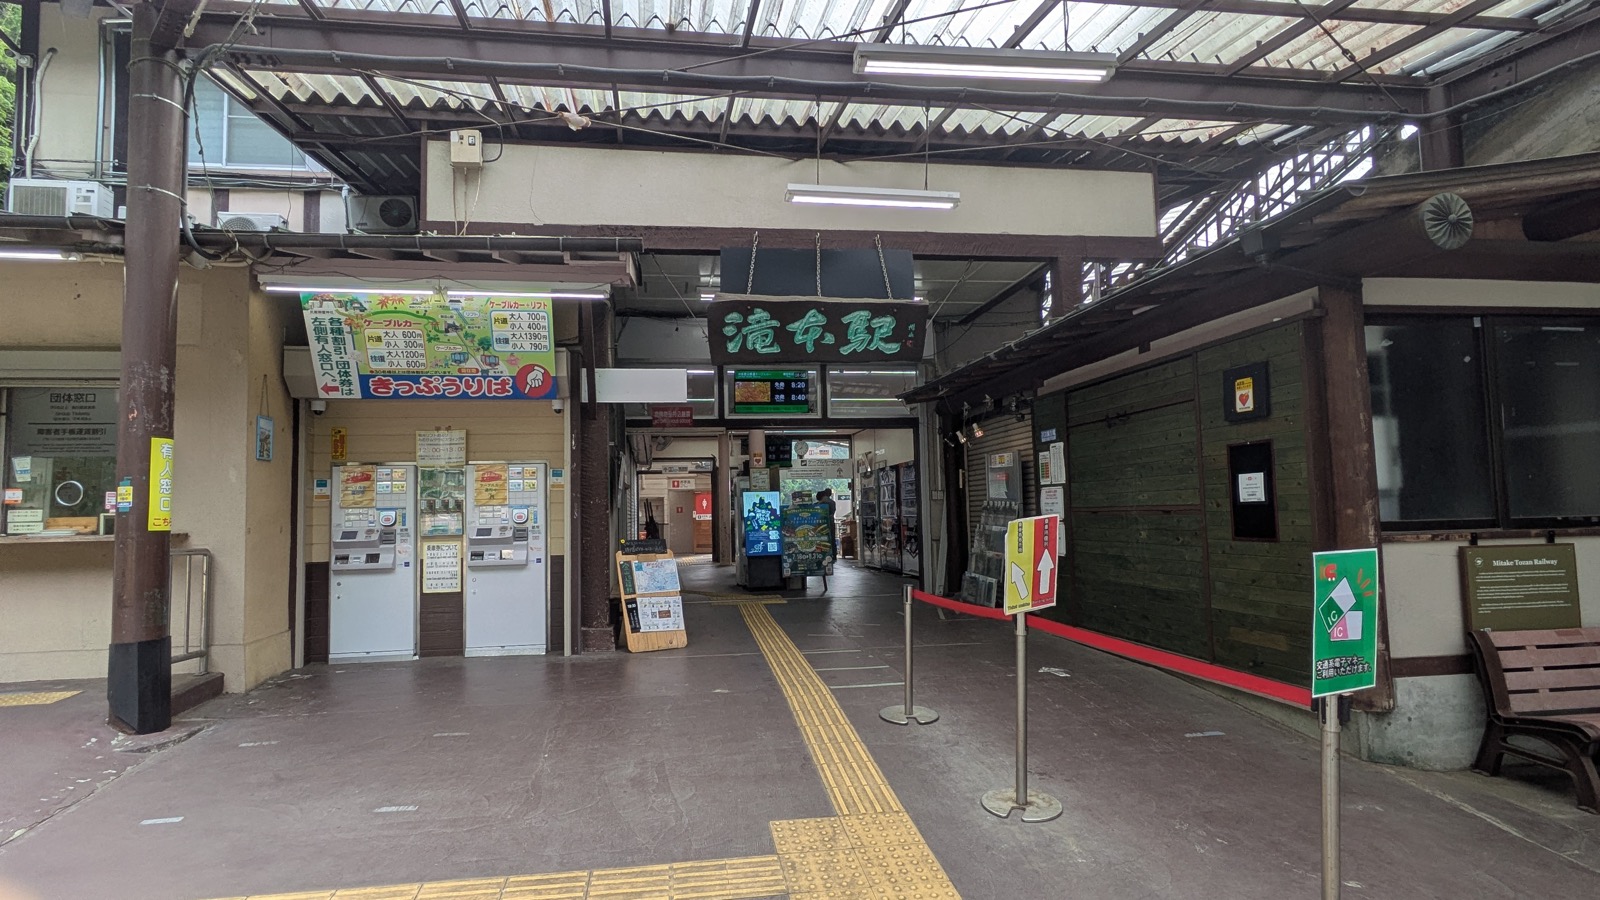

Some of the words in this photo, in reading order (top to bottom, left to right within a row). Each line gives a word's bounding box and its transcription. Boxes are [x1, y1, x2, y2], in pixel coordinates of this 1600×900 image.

[509, 313, 523, 321] 大人
[527, 313, 546, 321] 700円
[364, 319, 422, 327] ケーブルカー
[510, 323, 524, 331] 小人
[527, 323, 546, 331] 400円
[402, 331, 422, 339] 600円
[722, 308, 901, 355] 滝本駅
[367, 335, 382, 343] 片道
[311, 317, 337, 382] 左側有人窓口へ。
[404, 341, 424, 349] 300円
[530, 343, 548, 351] 790円
[328, 317, 355, 396] 各種割引・団体券は
[406, 361, 425, 369] 600円
[369, 376, 513, 397] きっぷうりば
[49, 393, 96, 403] 団体窓口
[160, 443, 173, 512] 有人窓口
[1492, 559, 1514, 567] Mitake
[1534, 558, 1558, 566] Railway
[1327, 610, 1338, 626] IC
[1334, 626, 1344, 638] IC
[1316, 656, 1364, 671] 交通系電子マネー
[1316, 662, 1372, 679] ご利用いただけます。
